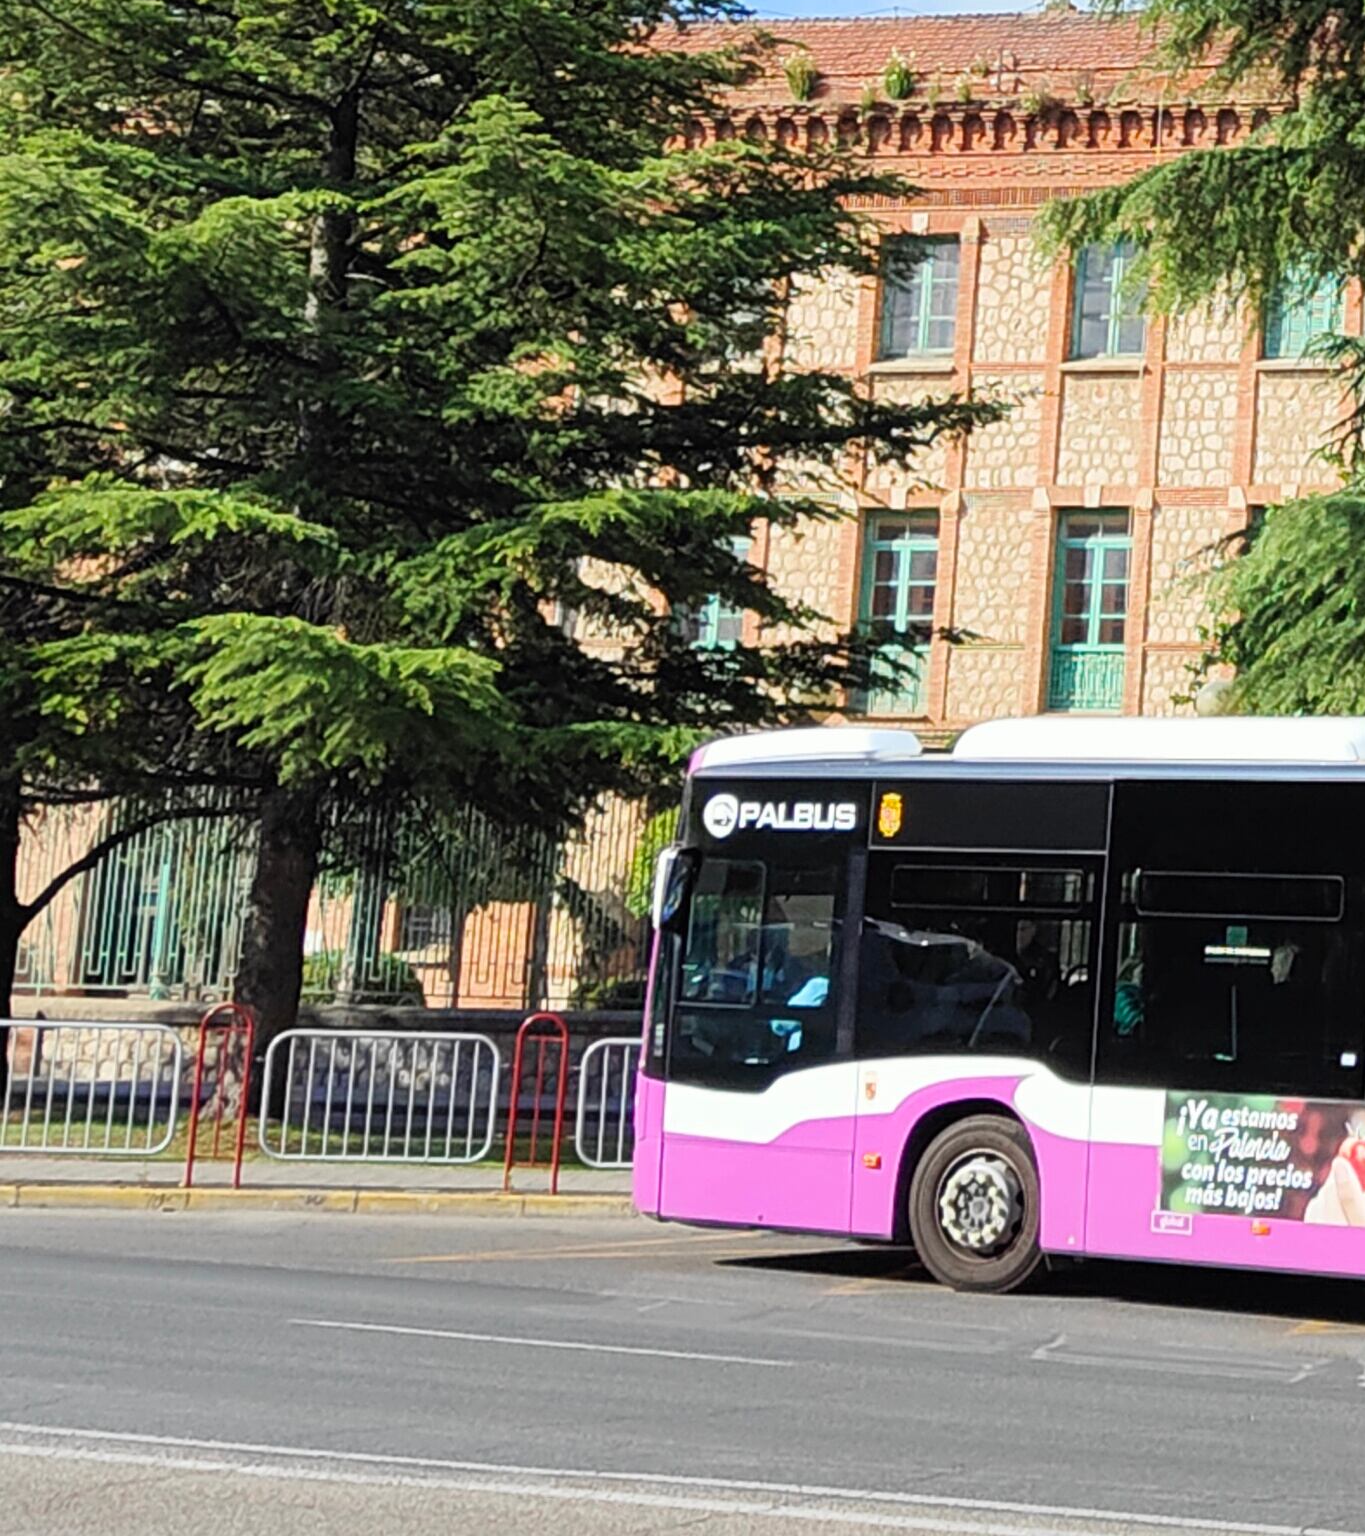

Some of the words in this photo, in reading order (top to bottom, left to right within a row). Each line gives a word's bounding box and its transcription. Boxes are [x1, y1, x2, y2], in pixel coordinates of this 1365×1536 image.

[738, 801, 856, 831] PALBUS
[1176, 1099, 1218, 1136] ¡Ya
[1220, 1108, 1298, 1130] estamos
[1187, 1133, 1208, 1151] en
[1209, 1127, 1291, 1162] Palencia
[1181, 1162, 1215, 1181] con
[1217, 1159, 1244, 1184] los
[1245, 1164, 1313, 1189] precios
[1184, 1183, 1223, 1207] más
[1224, 1184, 1283, 1214] bajos!
